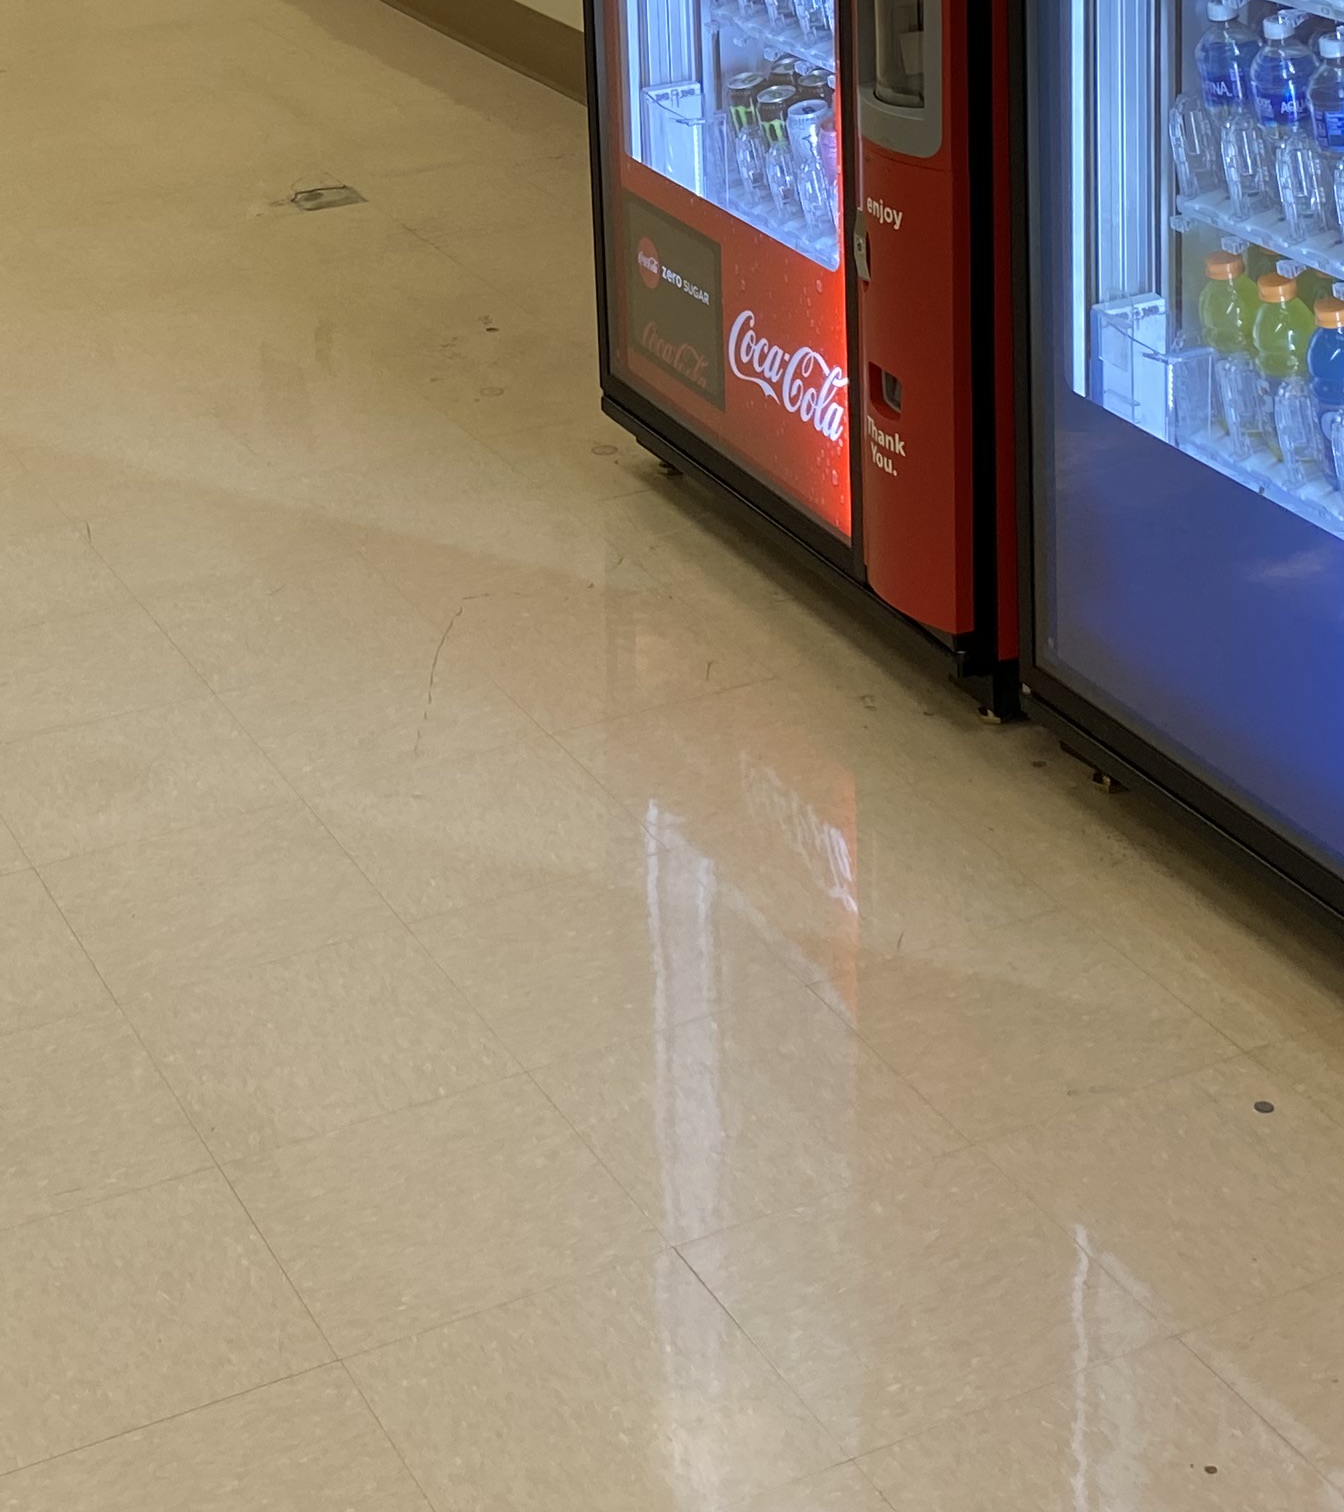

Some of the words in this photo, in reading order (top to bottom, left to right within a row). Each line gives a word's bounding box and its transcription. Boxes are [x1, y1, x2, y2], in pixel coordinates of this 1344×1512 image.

[867, 196, 903, 230] enjoy
[662, 265, 682, 288] zero
[683, 279, 710, 306] SUGAR
[728, 309, 849, 442] Coca-Cola
[867, 415, 906, 457] Thank
[871, 444, 898, 476] You.
